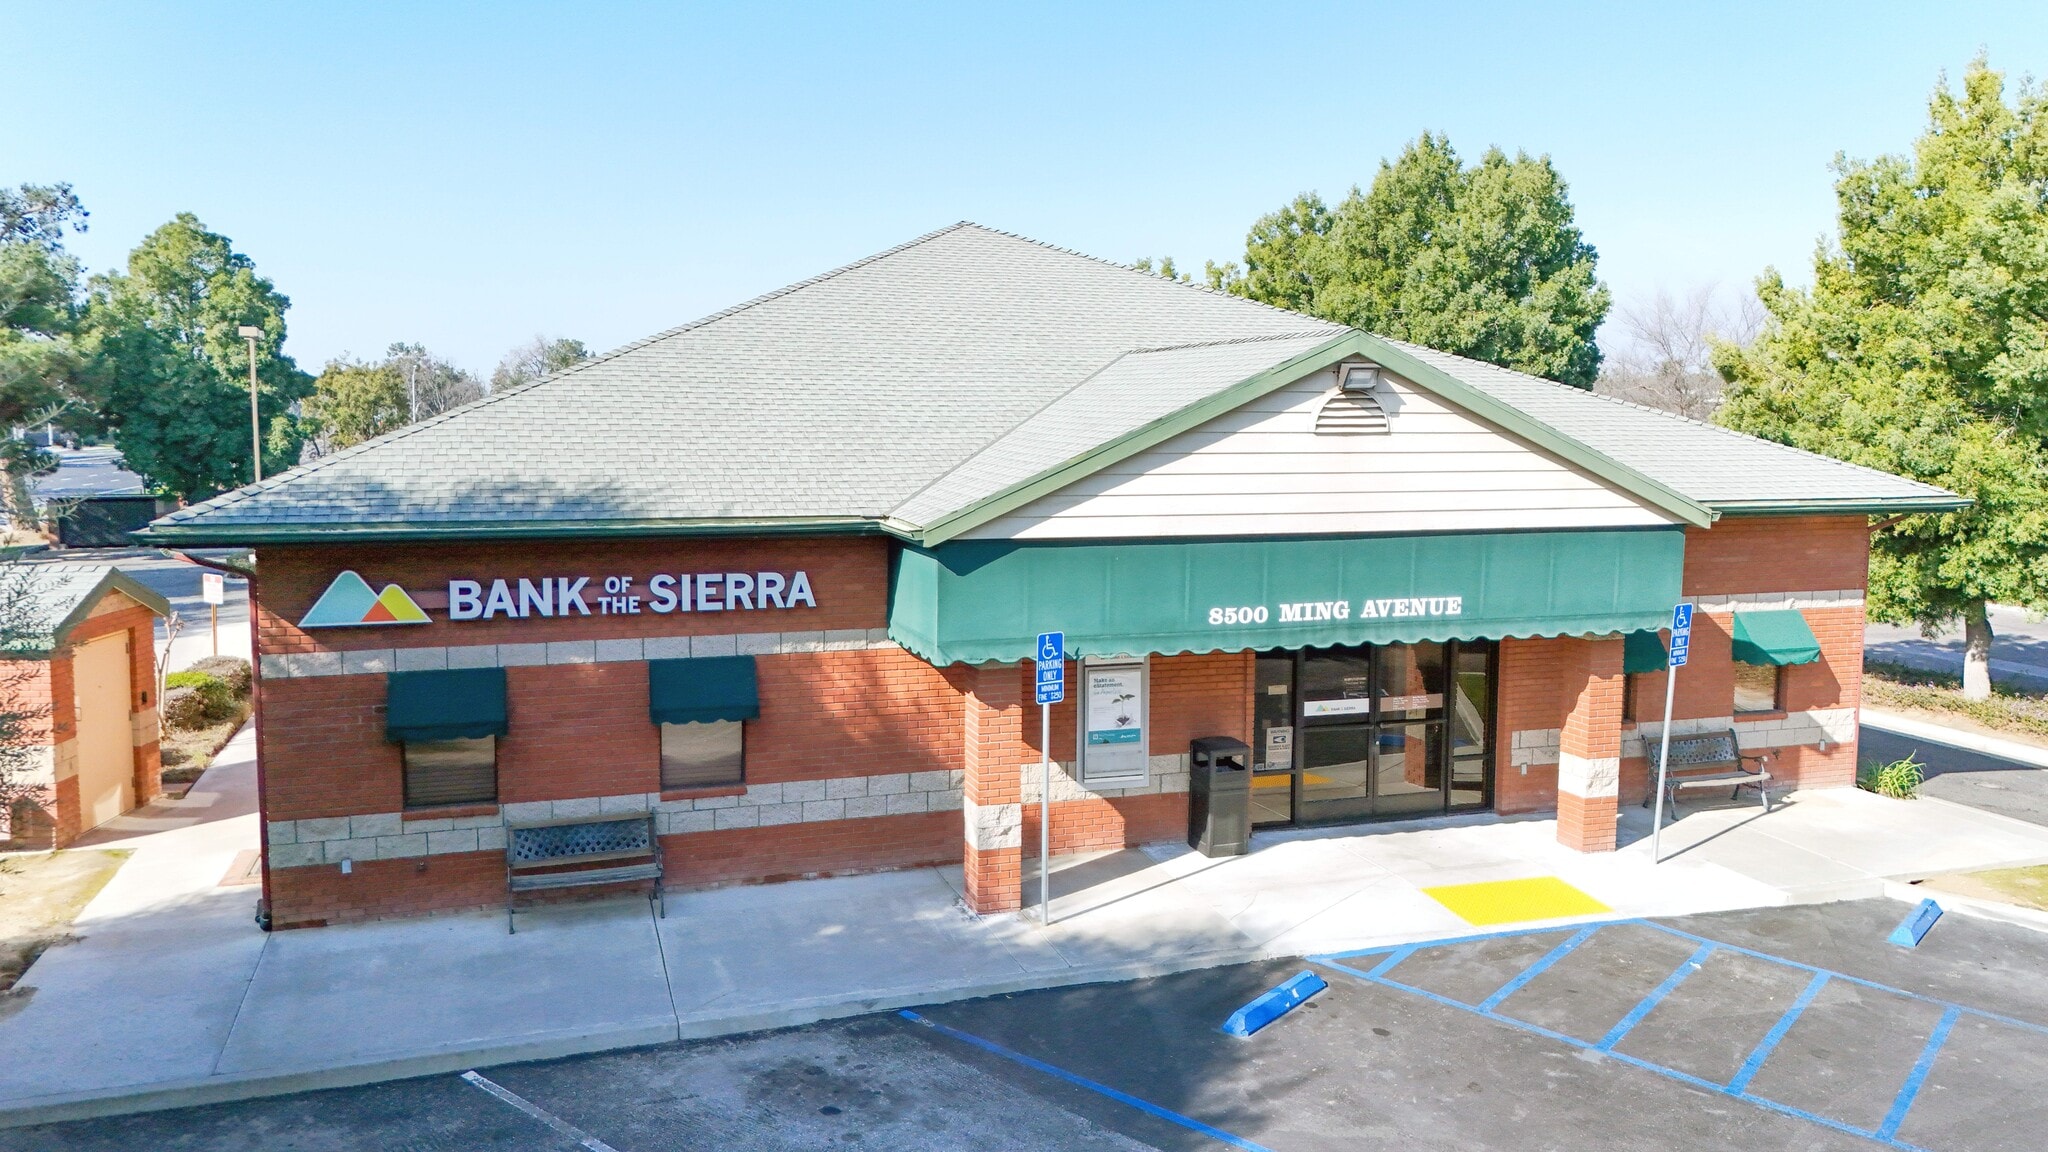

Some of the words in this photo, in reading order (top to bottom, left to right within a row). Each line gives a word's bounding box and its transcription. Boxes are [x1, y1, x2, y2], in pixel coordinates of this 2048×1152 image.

[605, 576, 632, 593] OF
[649, 571, 817, 613] SIERRA
[449, 577, 592, 620] BANK
[598, 596, 640, 614] THE
[1208, 606, 1269, 625] 8500
[1278, 600, 1350, 622] MING
[1360, 596, 1462, 619] AVENUE
[1038, 658, 1062, 671] PARKING
[1043, 670, 1057, 681] ONLY
[1039, 693, 1047, 701] FINE
